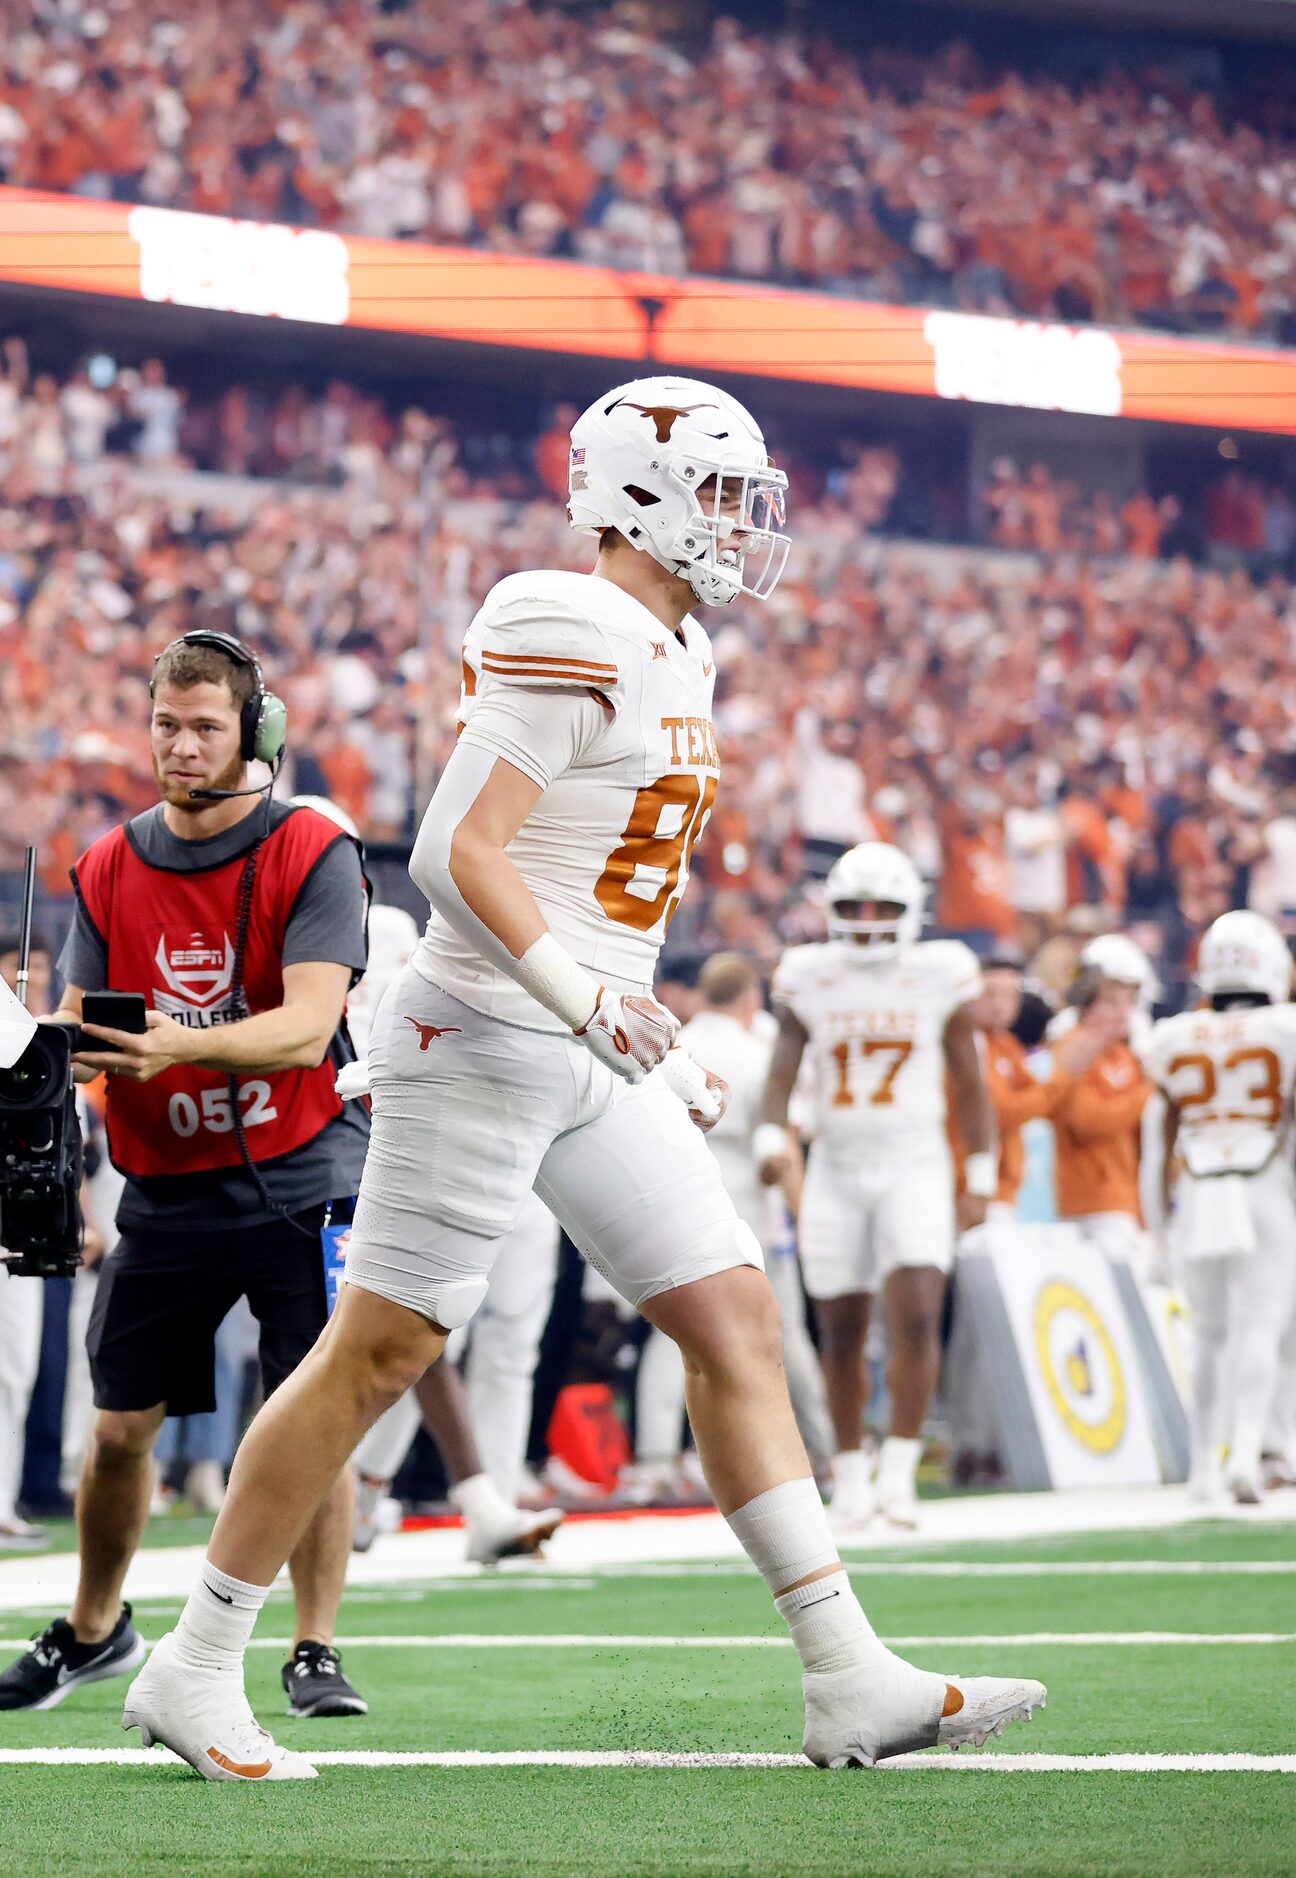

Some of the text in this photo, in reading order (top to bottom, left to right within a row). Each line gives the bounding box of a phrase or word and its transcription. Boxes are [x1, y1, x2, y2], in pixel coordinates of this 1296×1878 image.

[661, 716, 720, 770] TEXA
[170, 949, 223, 967] ESPN
[831, 1040, 914, 1106] 17
[1169, 1047, 1282, 1124] 23
[168, 1080, 278, 1148] 052
